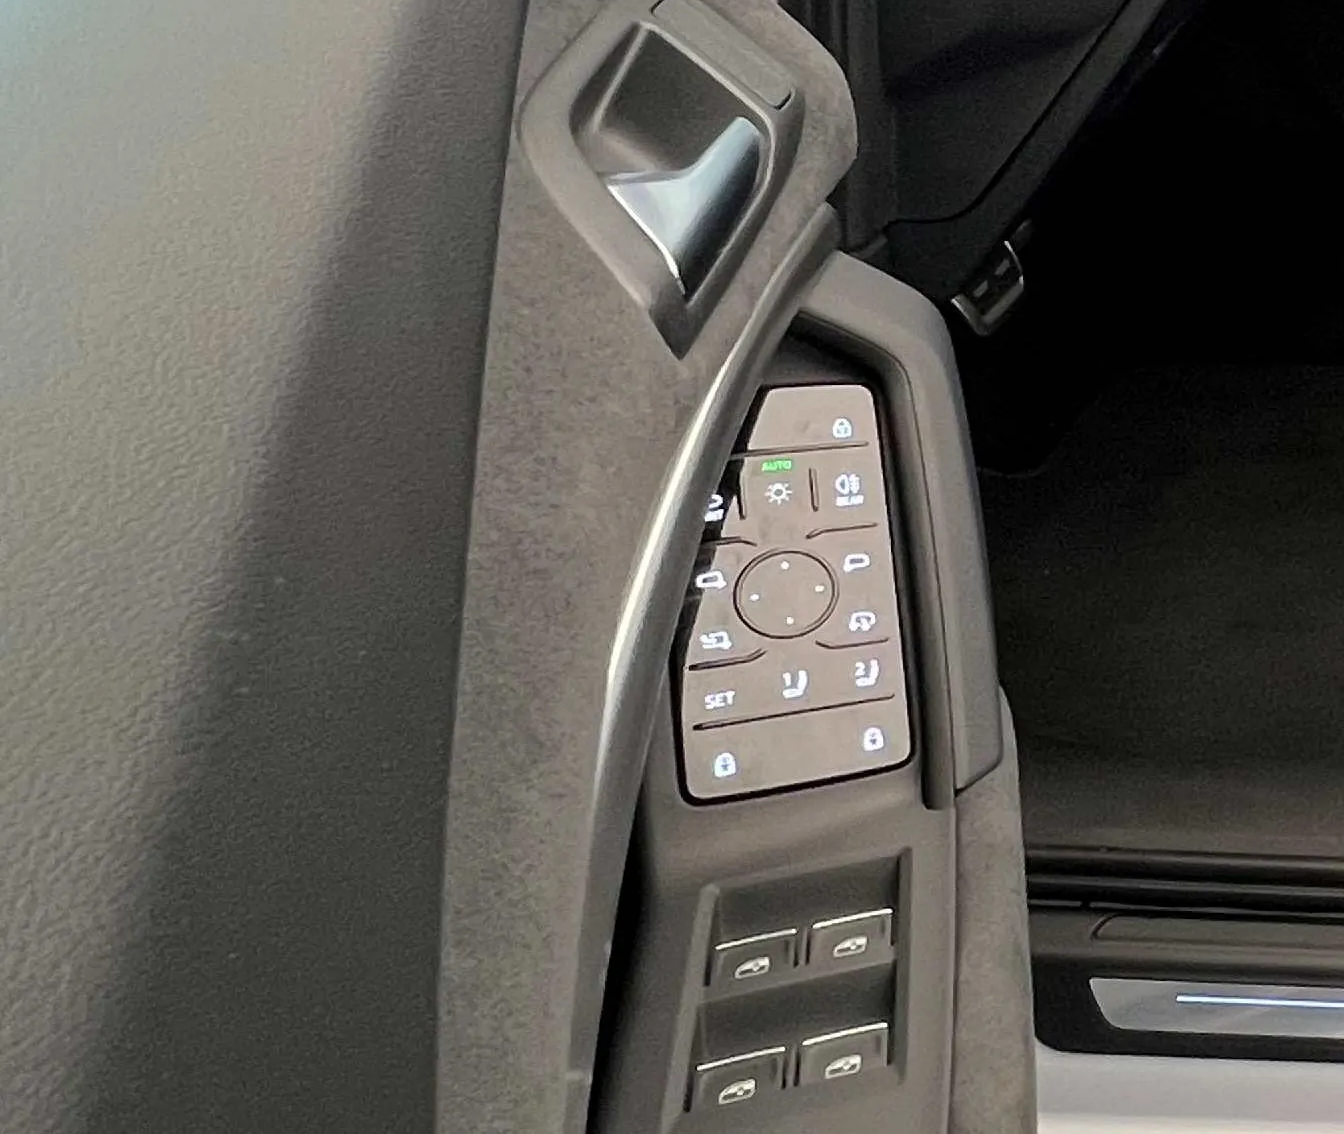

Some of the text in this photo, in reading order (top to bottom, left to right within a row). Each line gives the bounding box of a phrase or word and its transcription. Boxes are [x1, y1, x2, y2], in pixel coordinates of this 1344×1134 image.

[762, 460, 792, 472] AUTO
[854, 661, 866, 676] 2
[782, 672, 792, 687] 1
[704, 690, 736, 709] SET
